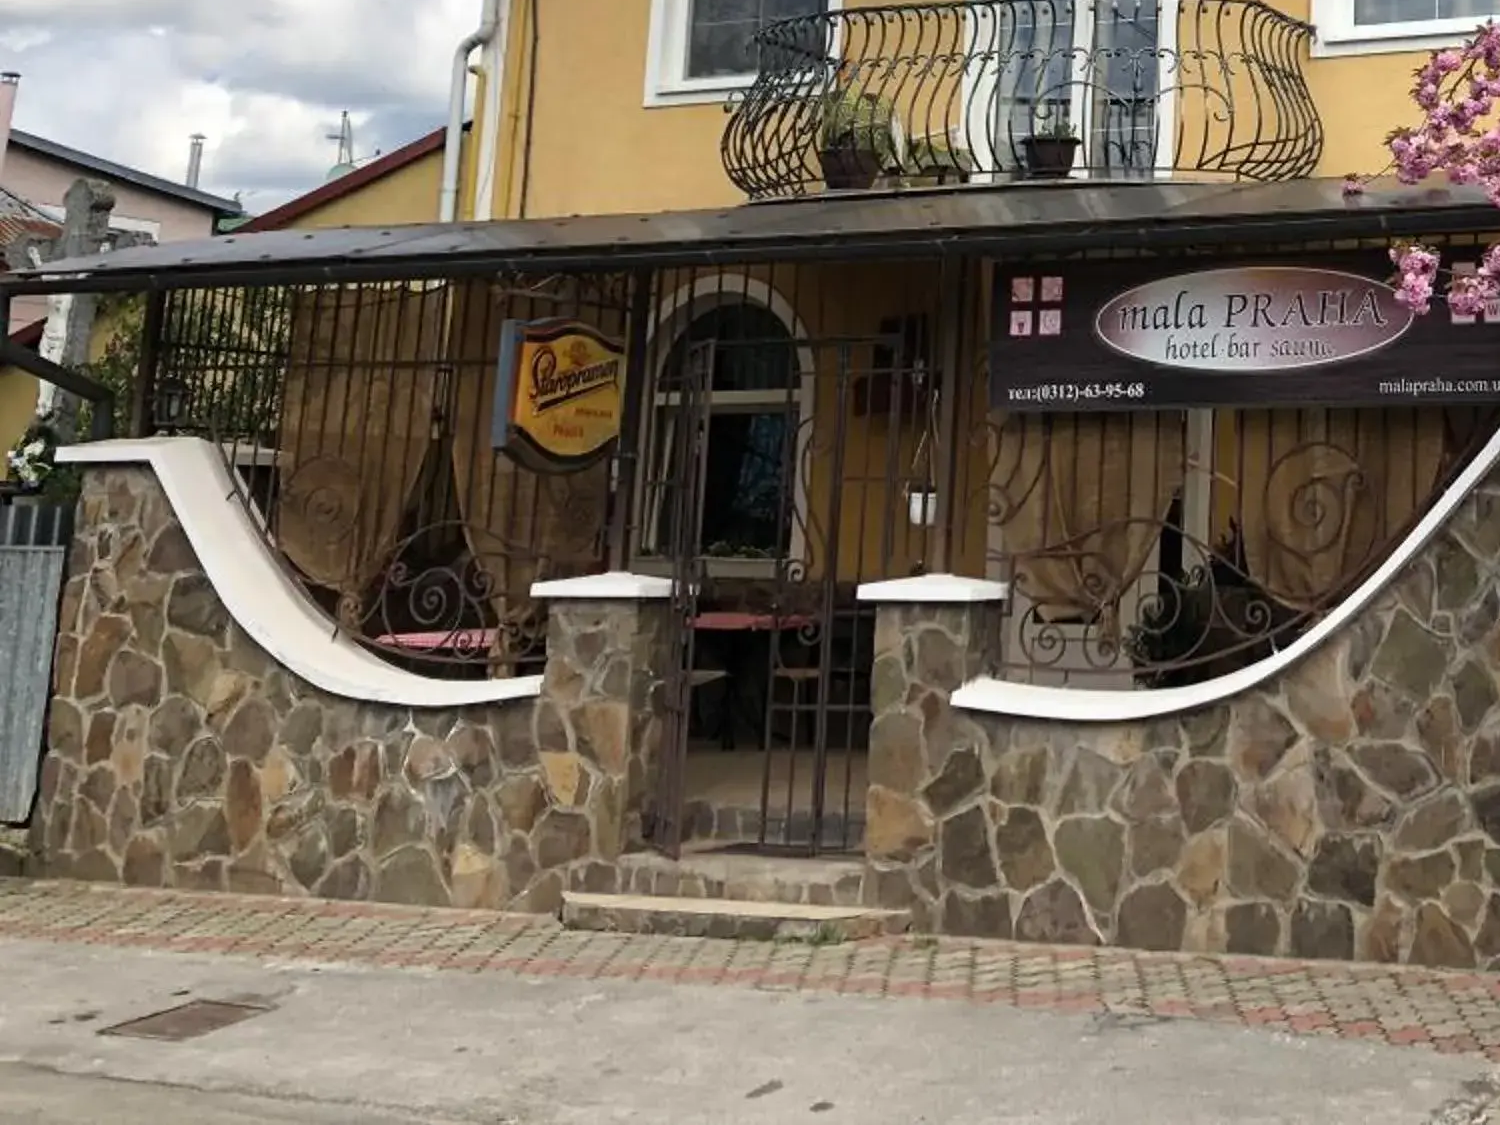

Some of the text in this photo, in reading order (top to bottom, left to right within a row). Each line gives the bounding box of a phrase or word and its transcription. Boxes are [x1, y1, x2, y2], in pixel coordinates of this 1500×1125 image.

[1119, 288, 1390, 331] mala PRAHA
[1165, 332, 1218, 360] hotel
[1226, 332, 1261, 359] bar
